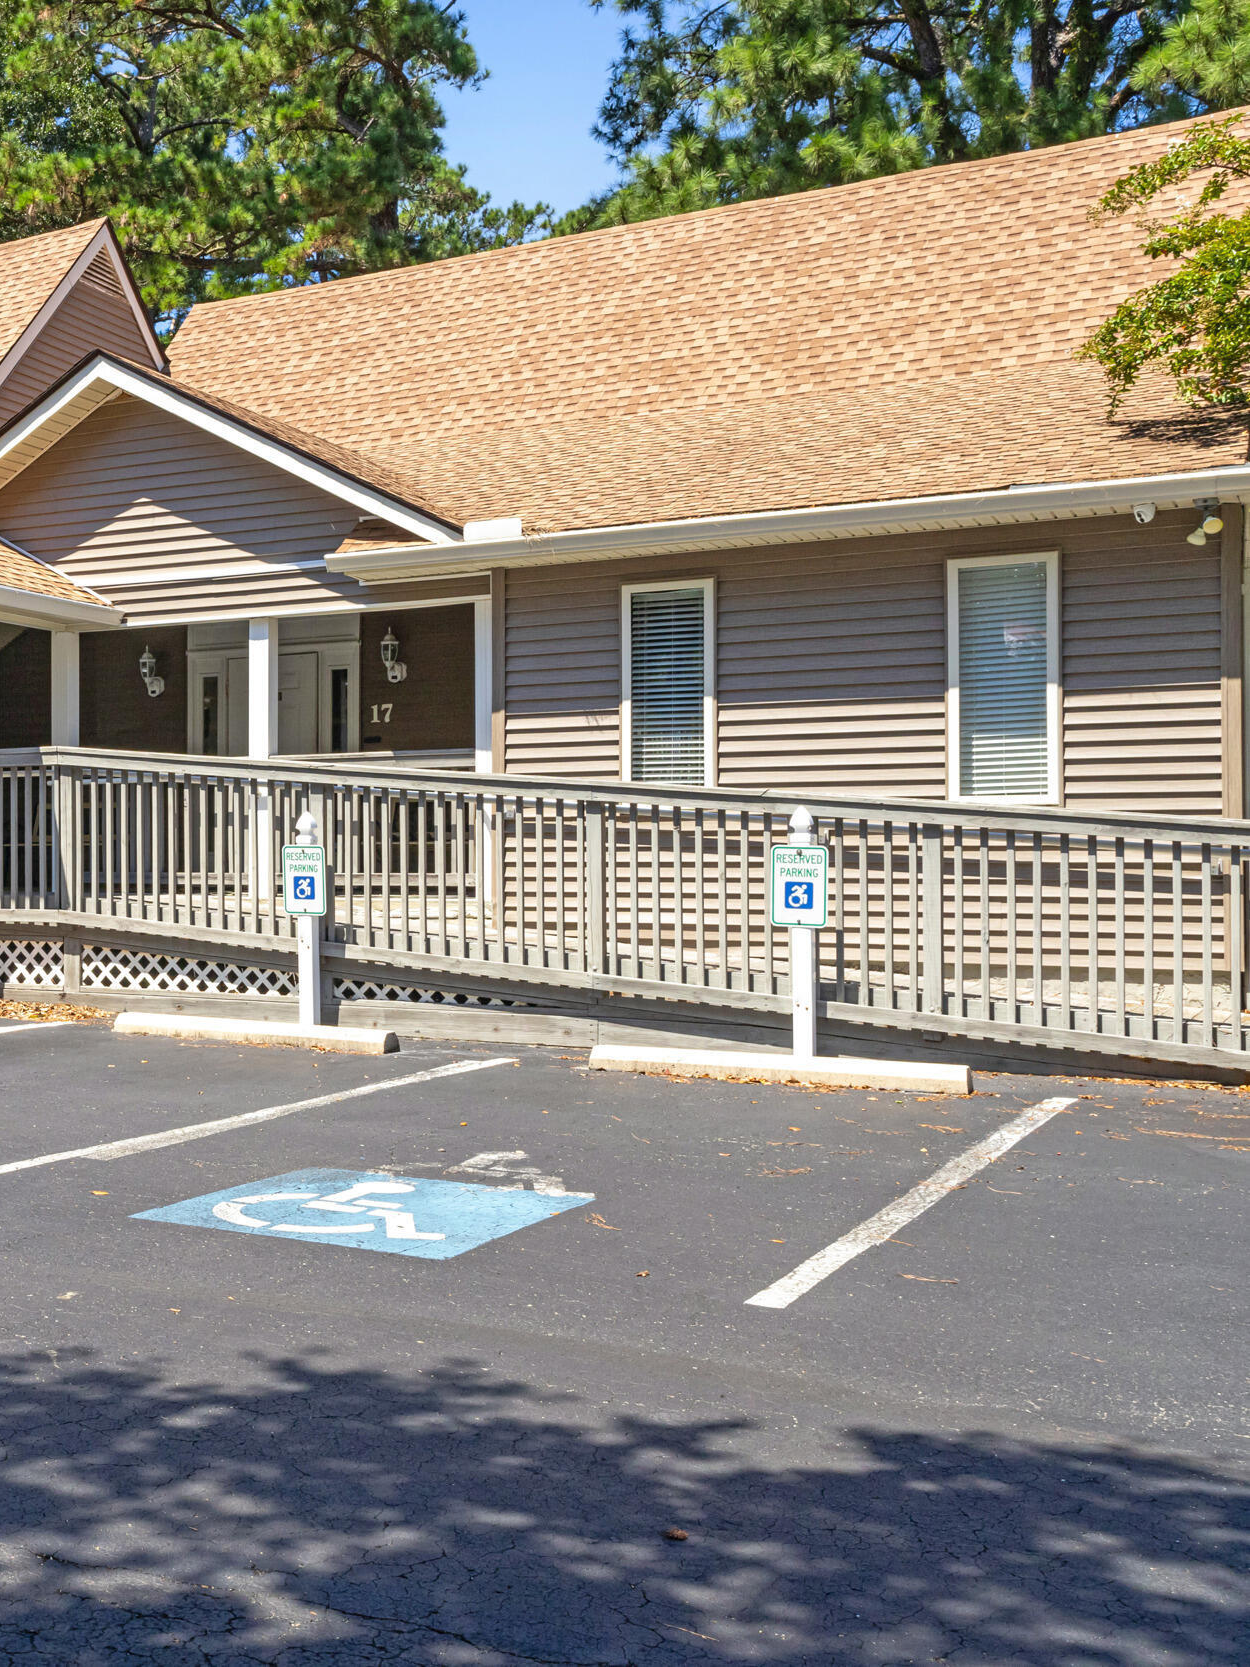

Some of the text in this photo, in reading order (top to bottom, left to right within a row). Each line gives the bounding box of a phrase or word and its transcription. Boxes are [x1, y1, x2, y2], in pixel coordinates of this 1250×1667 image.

[370, 703, 393, 723] 17
[286, 852, 321, 861] RESERVED
[776, 853, 823, 865] RESERVED
[289, 864, 318, 873] PARKING
[780, 867, 819, 878] PARKING
